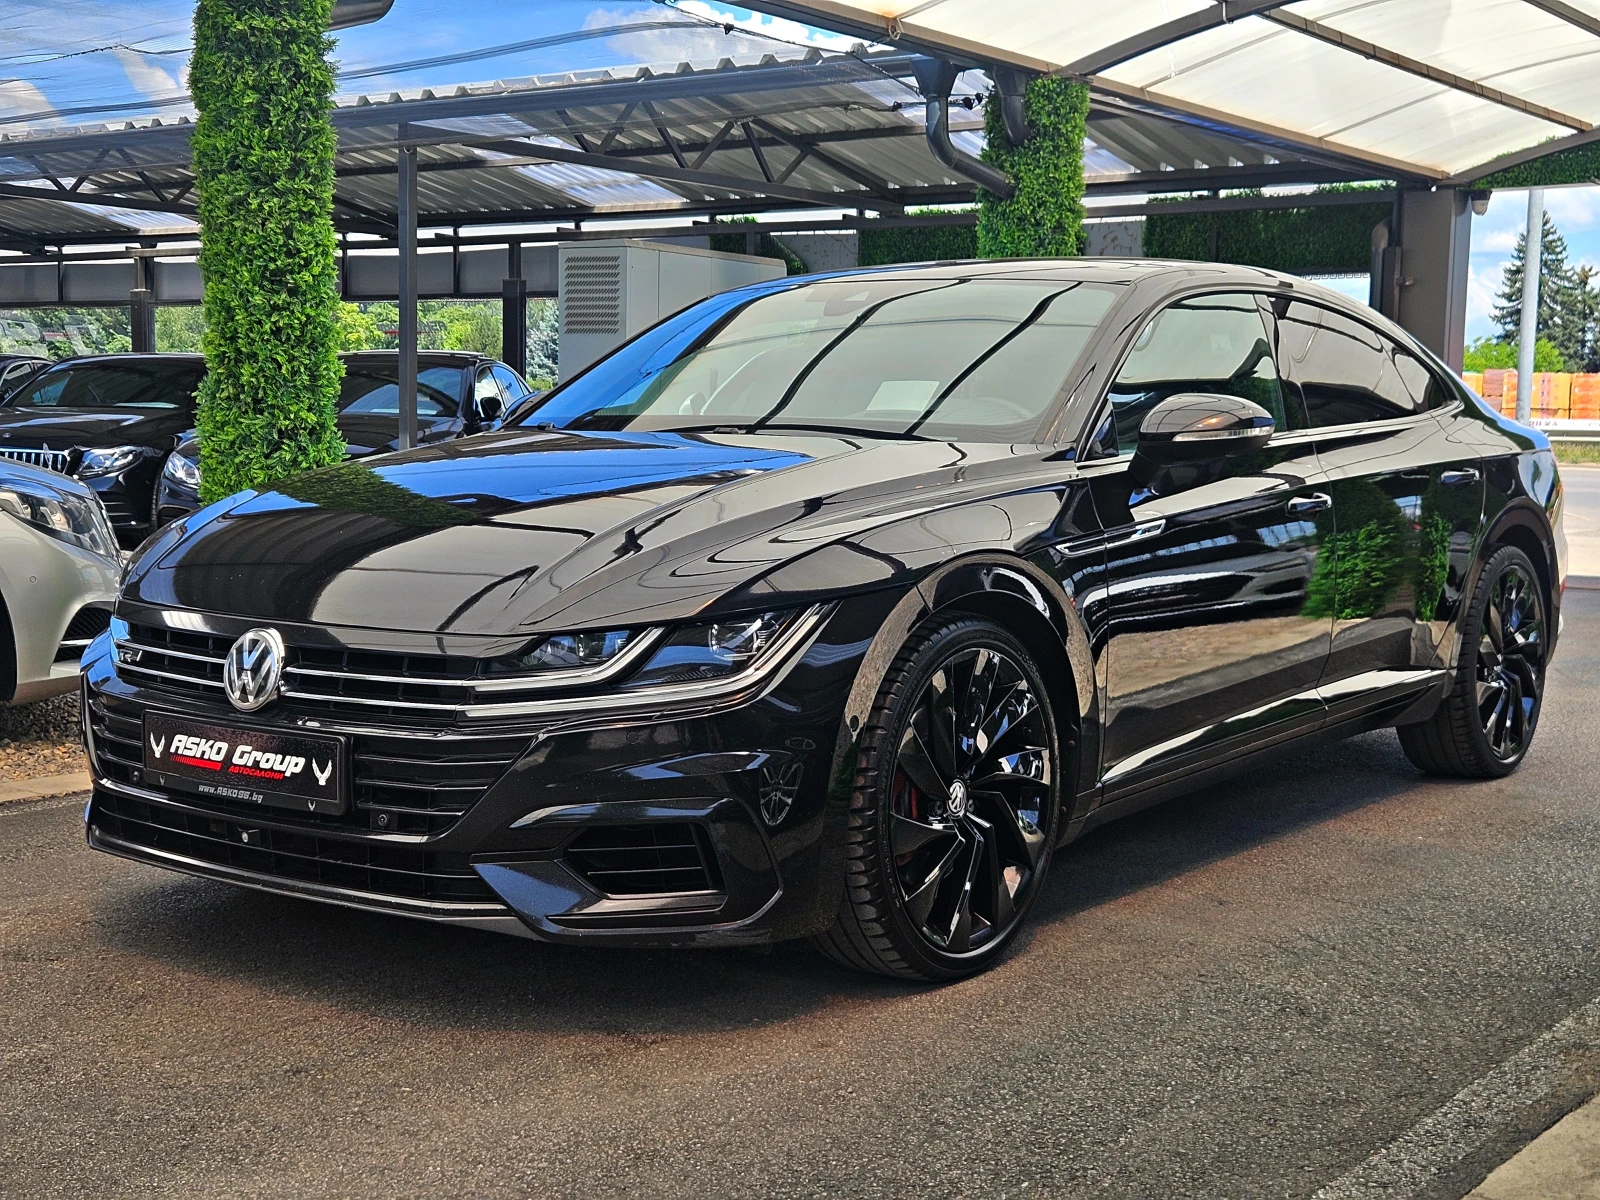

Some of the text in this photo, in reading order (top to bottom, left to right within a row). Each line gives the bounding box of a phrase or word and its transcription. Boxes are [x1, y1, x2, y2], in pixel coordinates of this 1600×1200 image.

[170, 735, 305, 776] ASKO Group
[228, 766, 284, 780] АВТОСАЛОНИ
